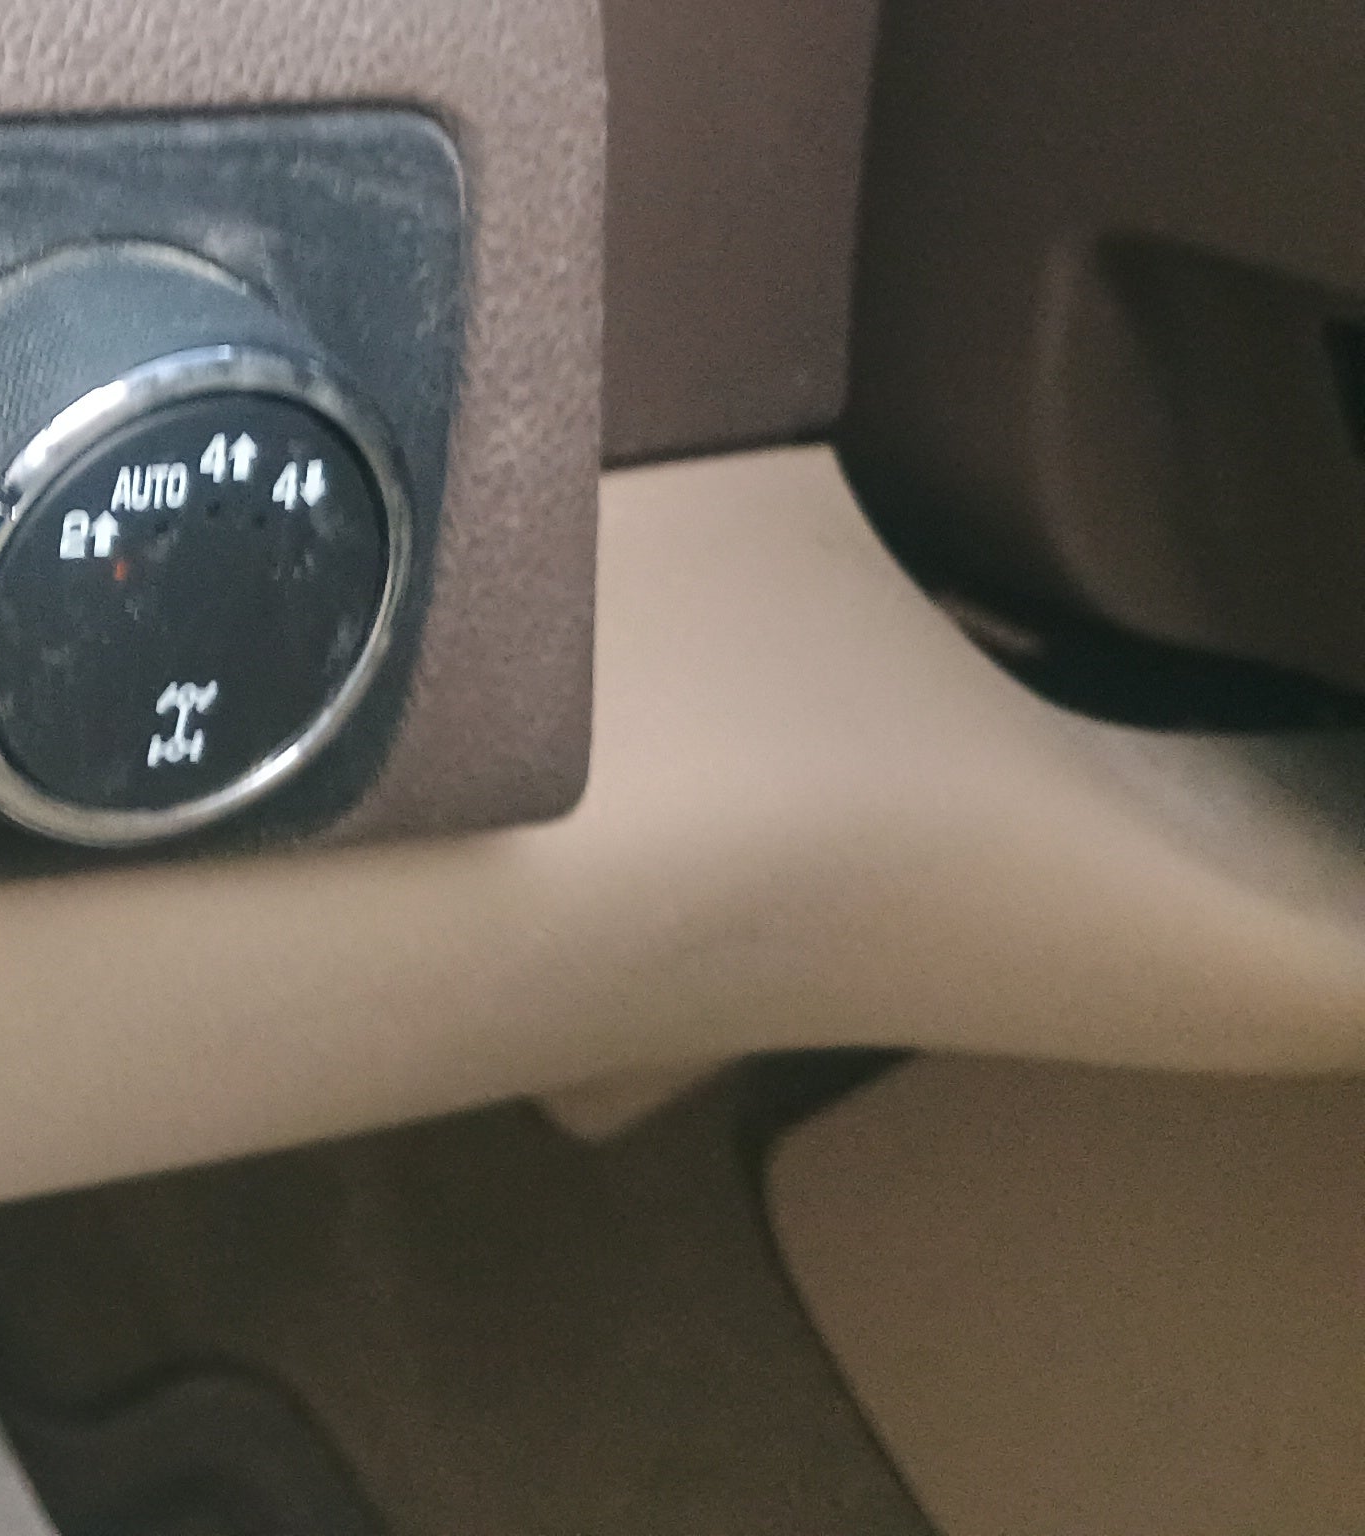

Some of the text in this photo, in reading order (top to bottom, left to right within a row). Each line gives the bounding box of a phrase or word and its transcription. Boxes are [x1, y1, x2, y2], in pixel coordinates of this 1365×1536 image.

[200, 431, 227, 484] 4
[110, 462, 190, 512] AUTO
[272, 461, 298, 510] 4
